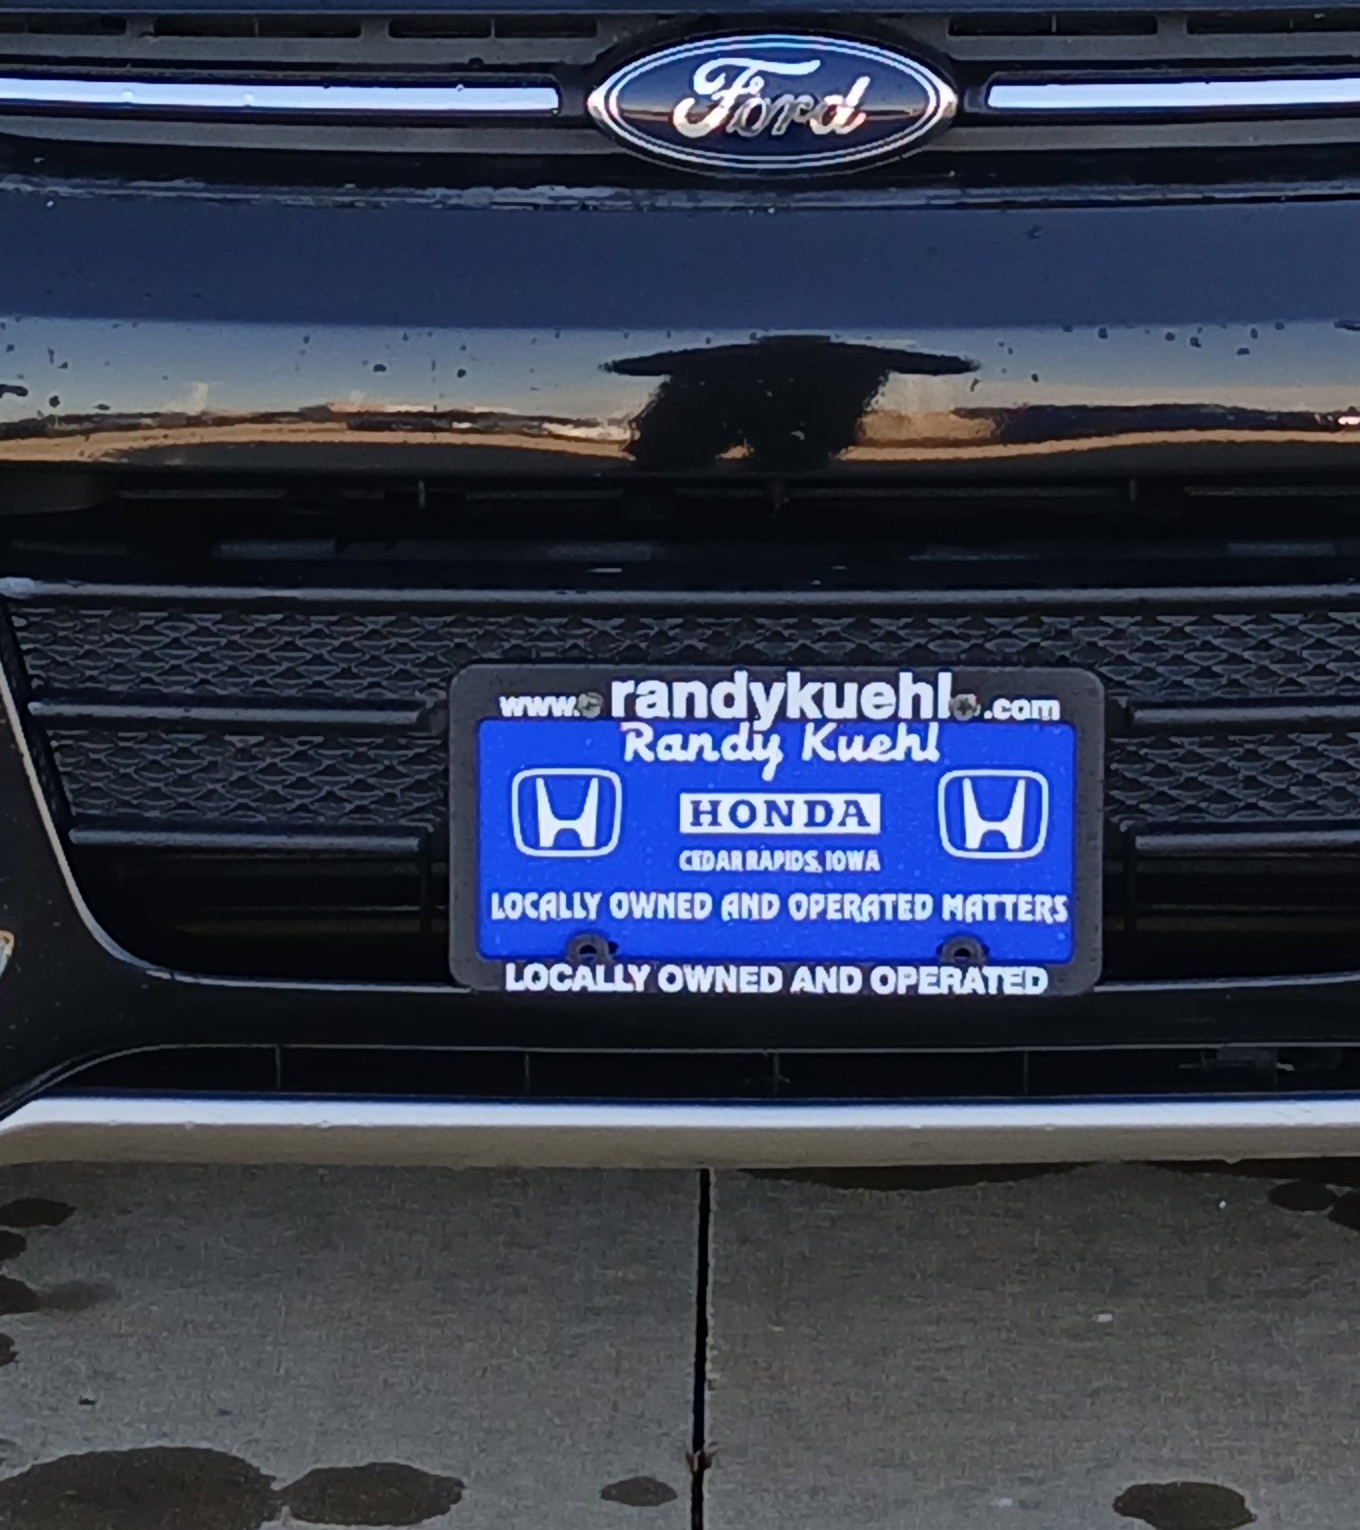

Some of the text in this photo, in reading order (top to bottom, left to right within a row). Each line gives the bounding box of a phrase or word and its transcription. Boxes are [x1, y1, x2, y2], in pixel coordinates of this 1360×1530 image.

[673, 57, 868, 138] Ford
[499, 670, 1061, 731] www. randykuehl .com
[620, 721, 940, 782] Randy Kuehl
[689, 799, 872, 829] HONDA
[679, 849, 743, 872] CEDAR
[825, 849, 881, 872] IOWA
[491, 891, 1069, 924] LOCALLY OWNED AND OPERATED MATTERS
[505, 962, 1049, 996] LOCALLY OWNED AND OPERATED
